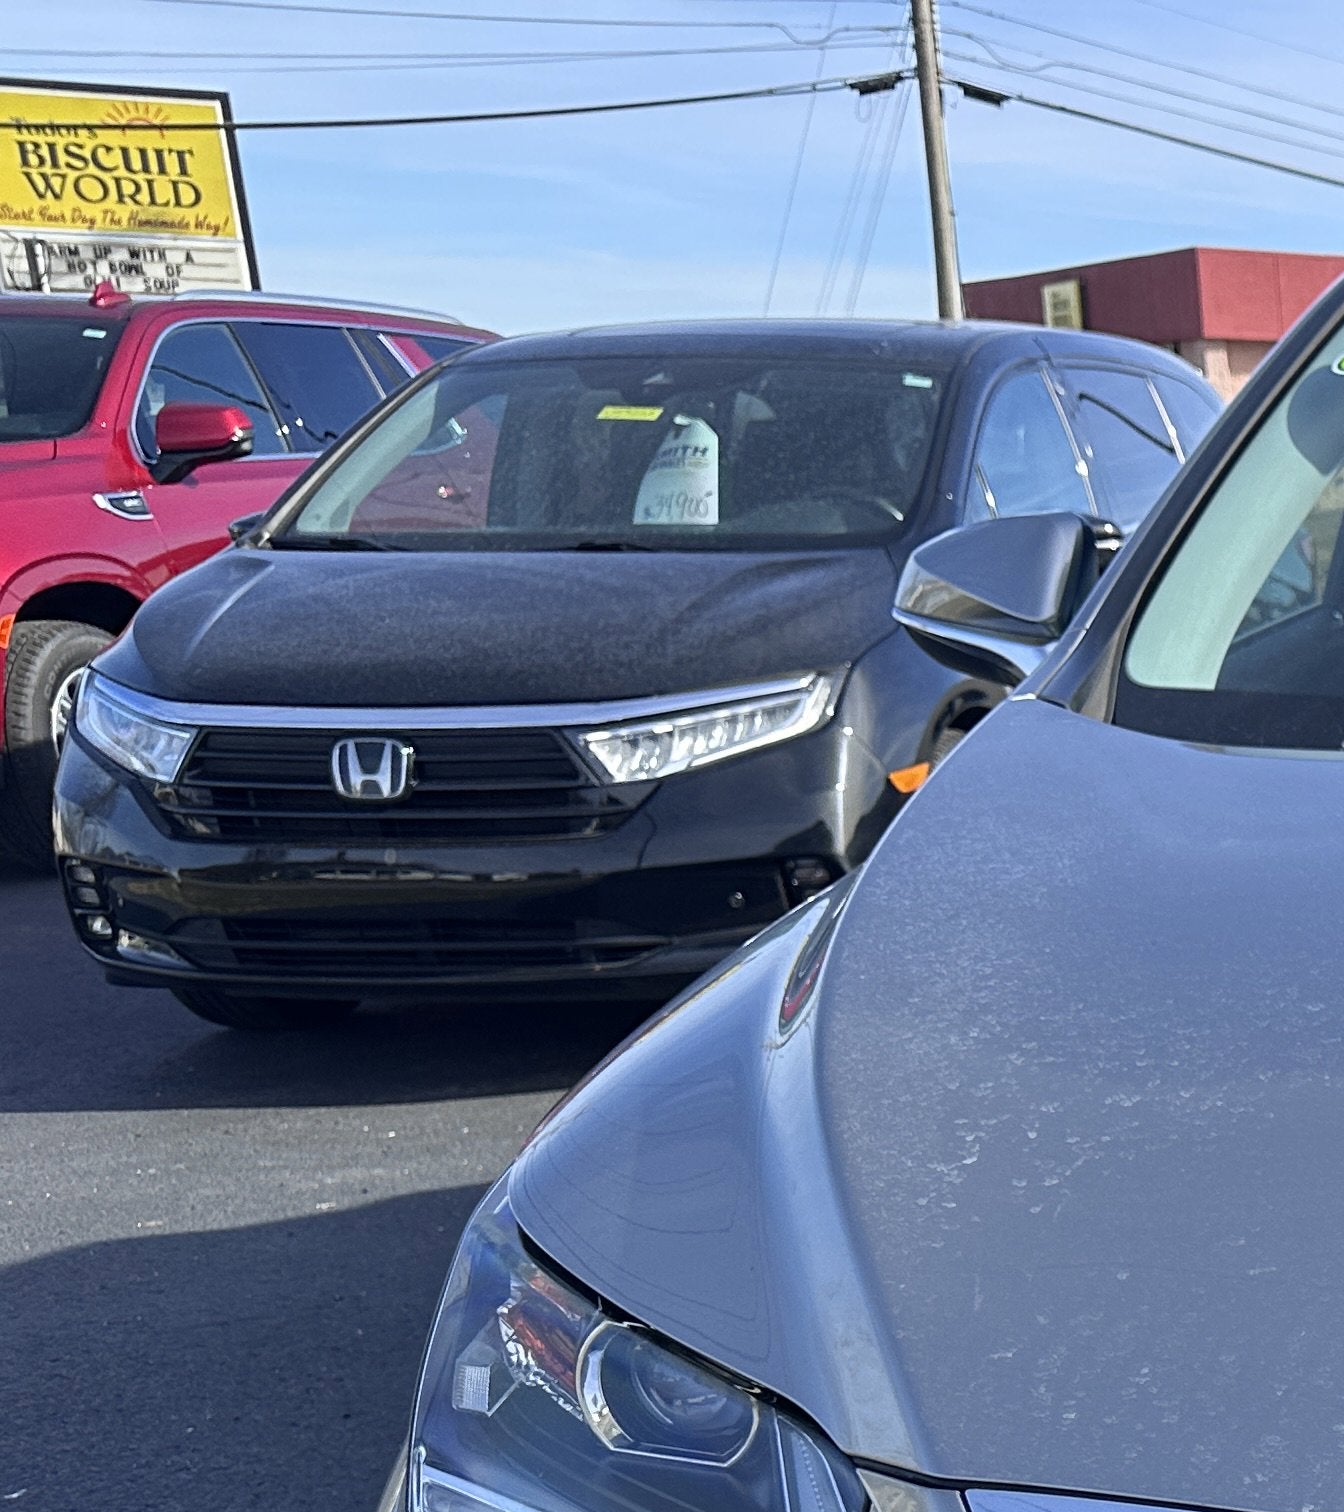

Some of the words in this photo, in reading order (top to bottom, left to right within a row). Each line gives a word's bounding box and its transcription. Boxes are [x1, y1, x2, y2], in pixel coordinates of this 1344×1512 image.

[16, 139, 195, 177] BISCUIT
[22, 171, 202, 208] WORLD
[71, 206, 97, 231] Day
[103, 208, 123, 227] The
[128, 245, 167, 263] WITH
[185, 248, 195, 264] A
[109, 258, 147, 276] BOWL
[165, 263, 183, 278] OF
[143, 276, 181, 292] SOUP
